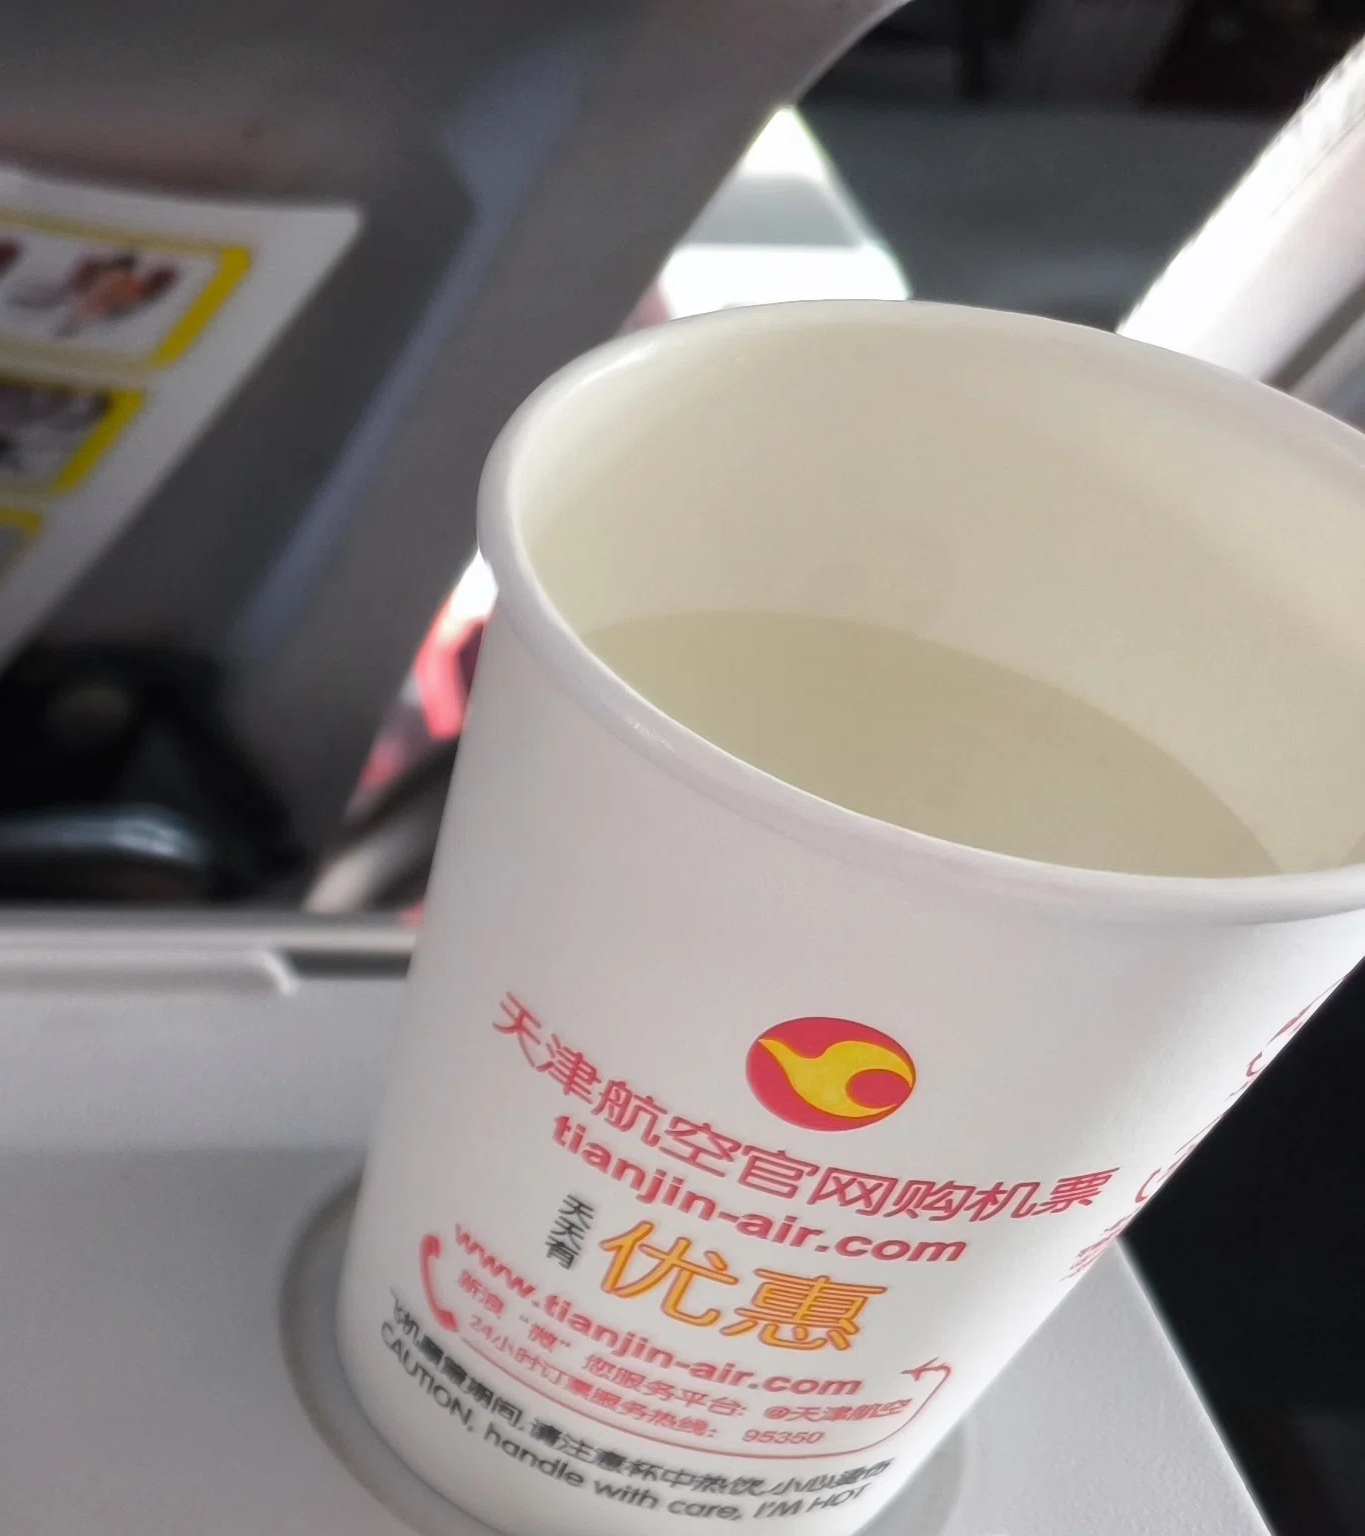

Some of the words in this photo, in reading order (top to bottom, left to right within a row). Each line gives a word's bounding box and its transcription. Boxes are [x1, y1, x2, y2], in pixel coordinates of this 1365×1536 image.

[491, 991, 1120, 1222] 天津航空官网购机票
[544, 1194, 595, 1270] 天天有
[553, 1115, 967, 1262] tianjin-air.com
[454, 1222, 863, 1396] www.tianjin-air.com
[598, 1220, 889, 1351] 优惠
[482, 1421, 585, 1486] handle
[592, 1477, 660, 1510] with
[666, 1498, 742, 1521] care,
[805, 1481, 872, 1514] HOT
[741, 1428, 826, 1445] 95350
